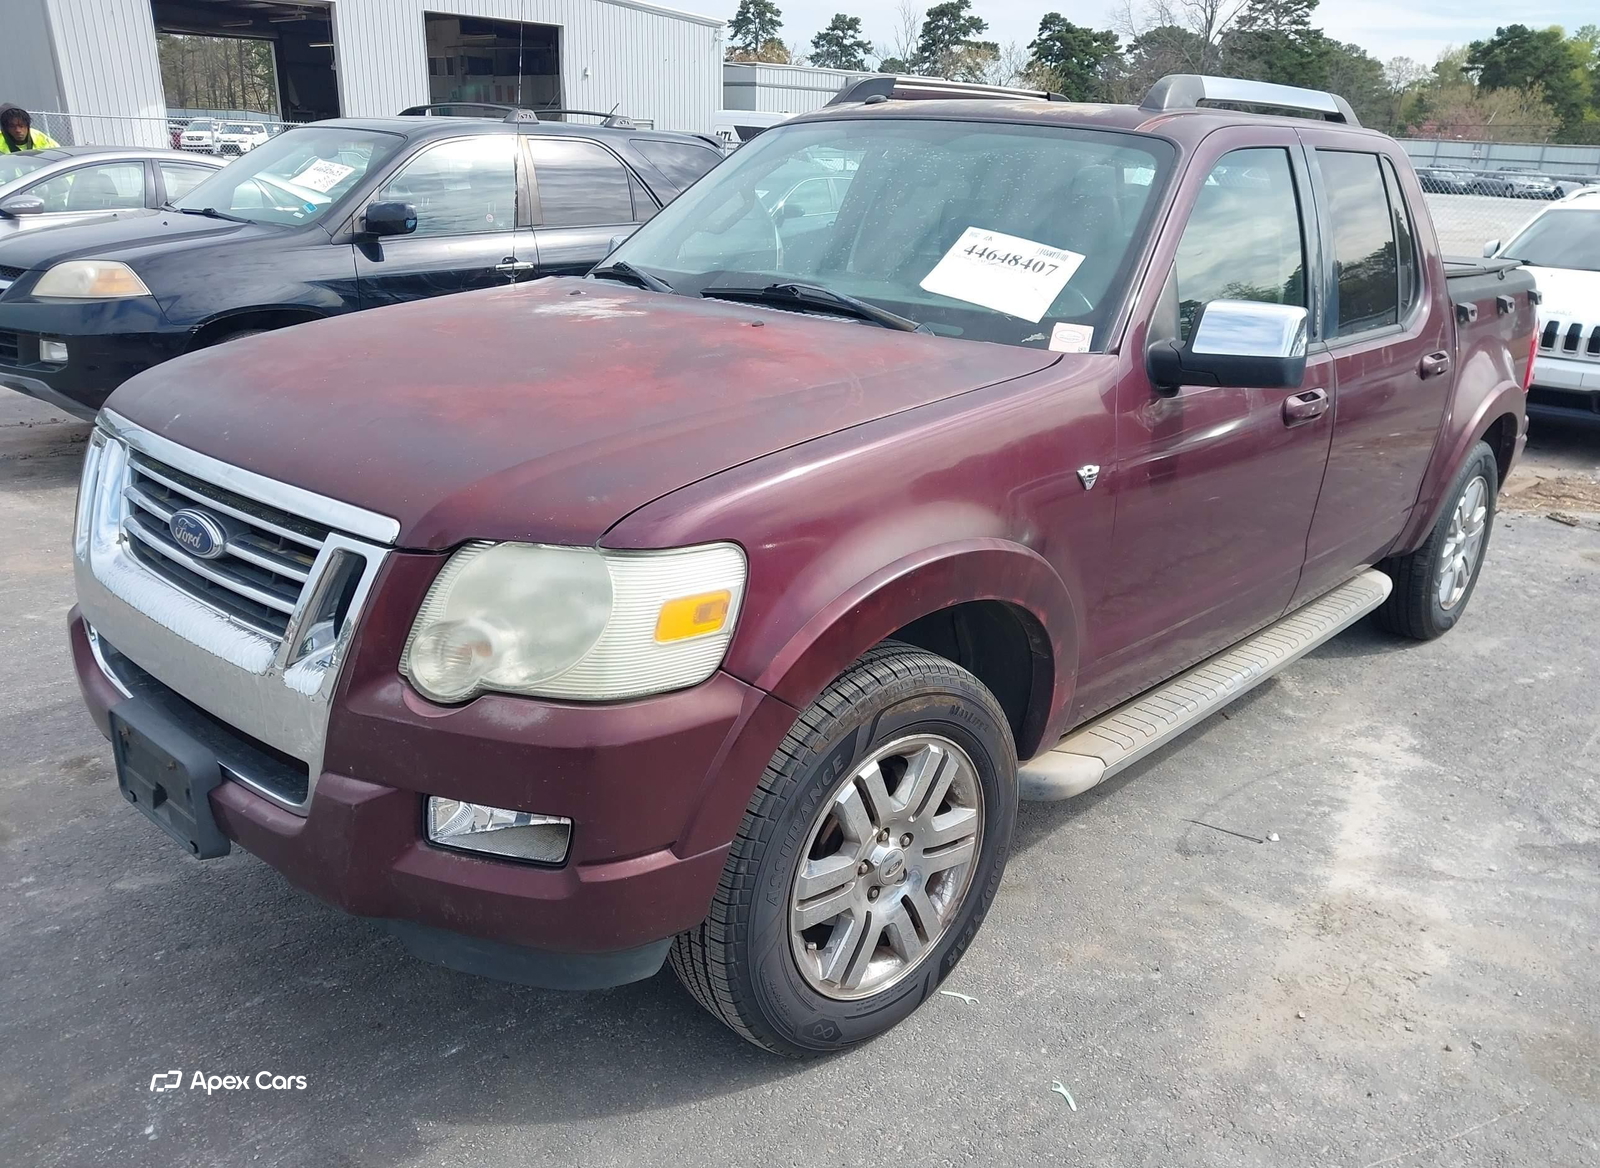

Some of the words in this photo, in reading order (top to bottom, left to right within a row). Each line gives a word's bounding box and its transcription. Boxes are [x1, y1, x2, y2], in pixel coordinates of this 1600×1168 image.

[963, 244, 1059, 277] 44648407
[175, 517, 202, 549] Ford
[766, 753, 844, 907] ASSURANCE
